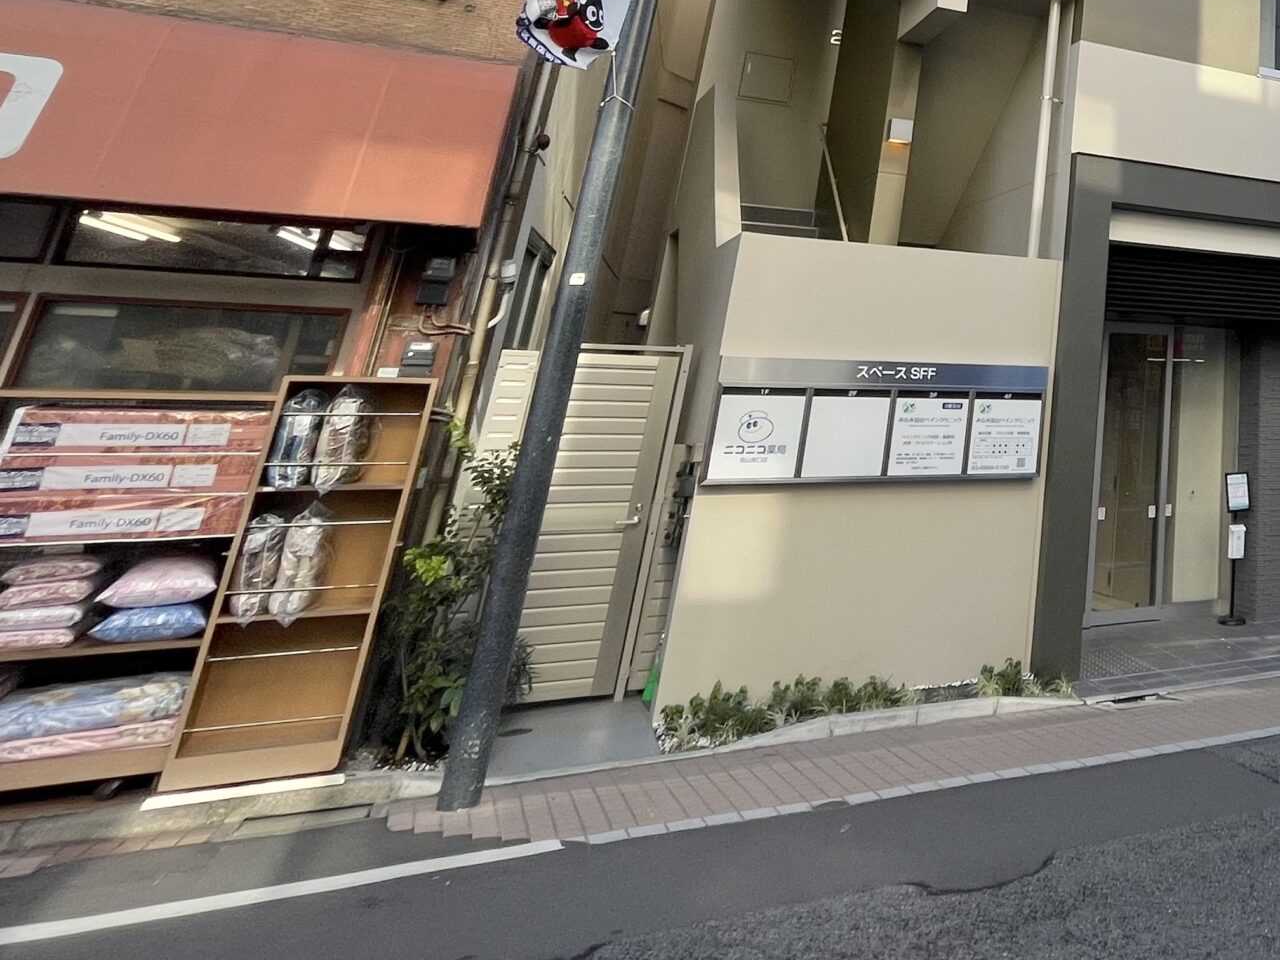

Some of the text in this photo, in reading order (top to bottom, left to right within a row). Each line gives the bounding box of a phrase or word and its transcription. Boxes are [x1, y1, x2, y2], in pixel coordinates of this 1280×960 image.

[856, 365, 937, 380] スペース SFF
[99, 431, 180, 442] Family-DX60
[84, 472, 165, 484] Family-DX60
